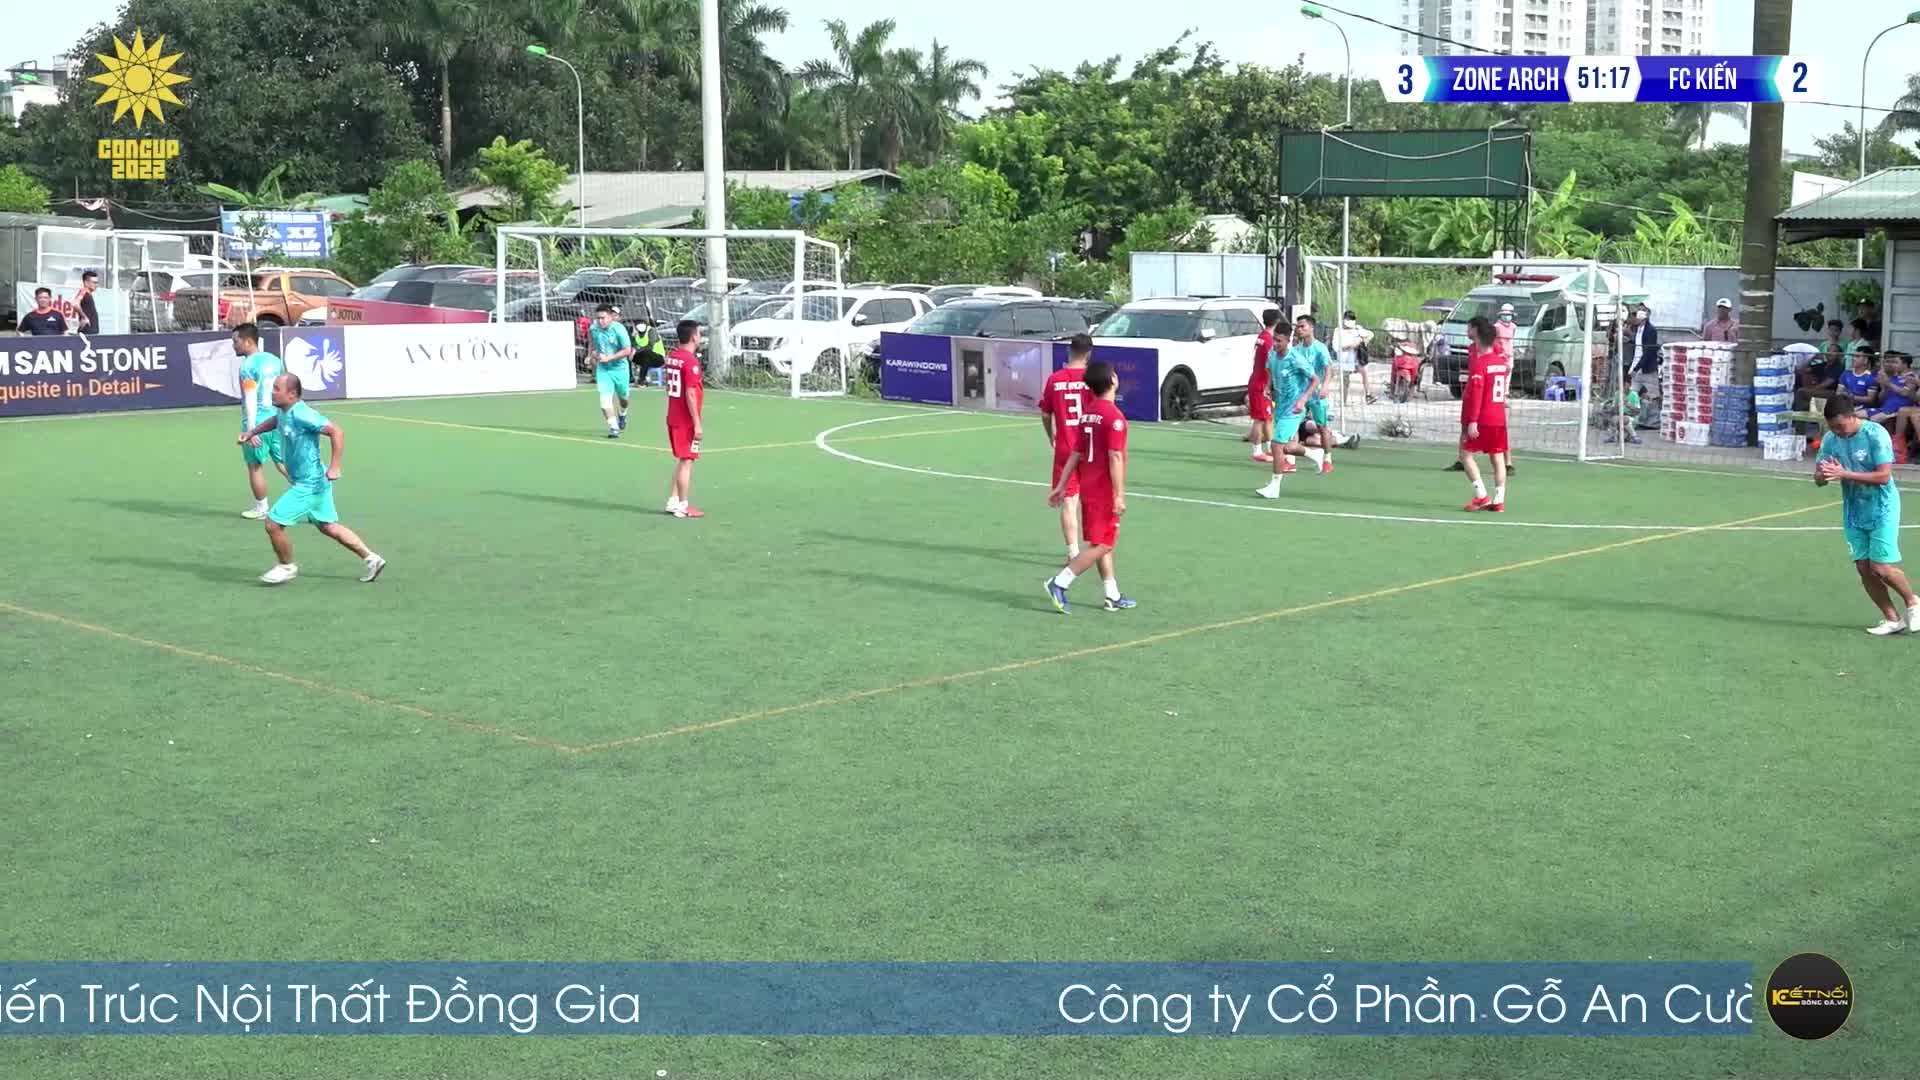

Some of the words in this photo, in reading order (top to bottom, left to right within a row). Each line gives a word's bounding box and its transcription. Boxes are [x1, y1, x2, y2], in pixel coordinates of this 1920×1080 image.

[14, 350, 73, 375] SAN
[80, 346, 168, 373] STONE
[66, 380, 83, 397] in
[88, 376, 141, 396] Detail
[1063, 393, 1083, 427] 3
